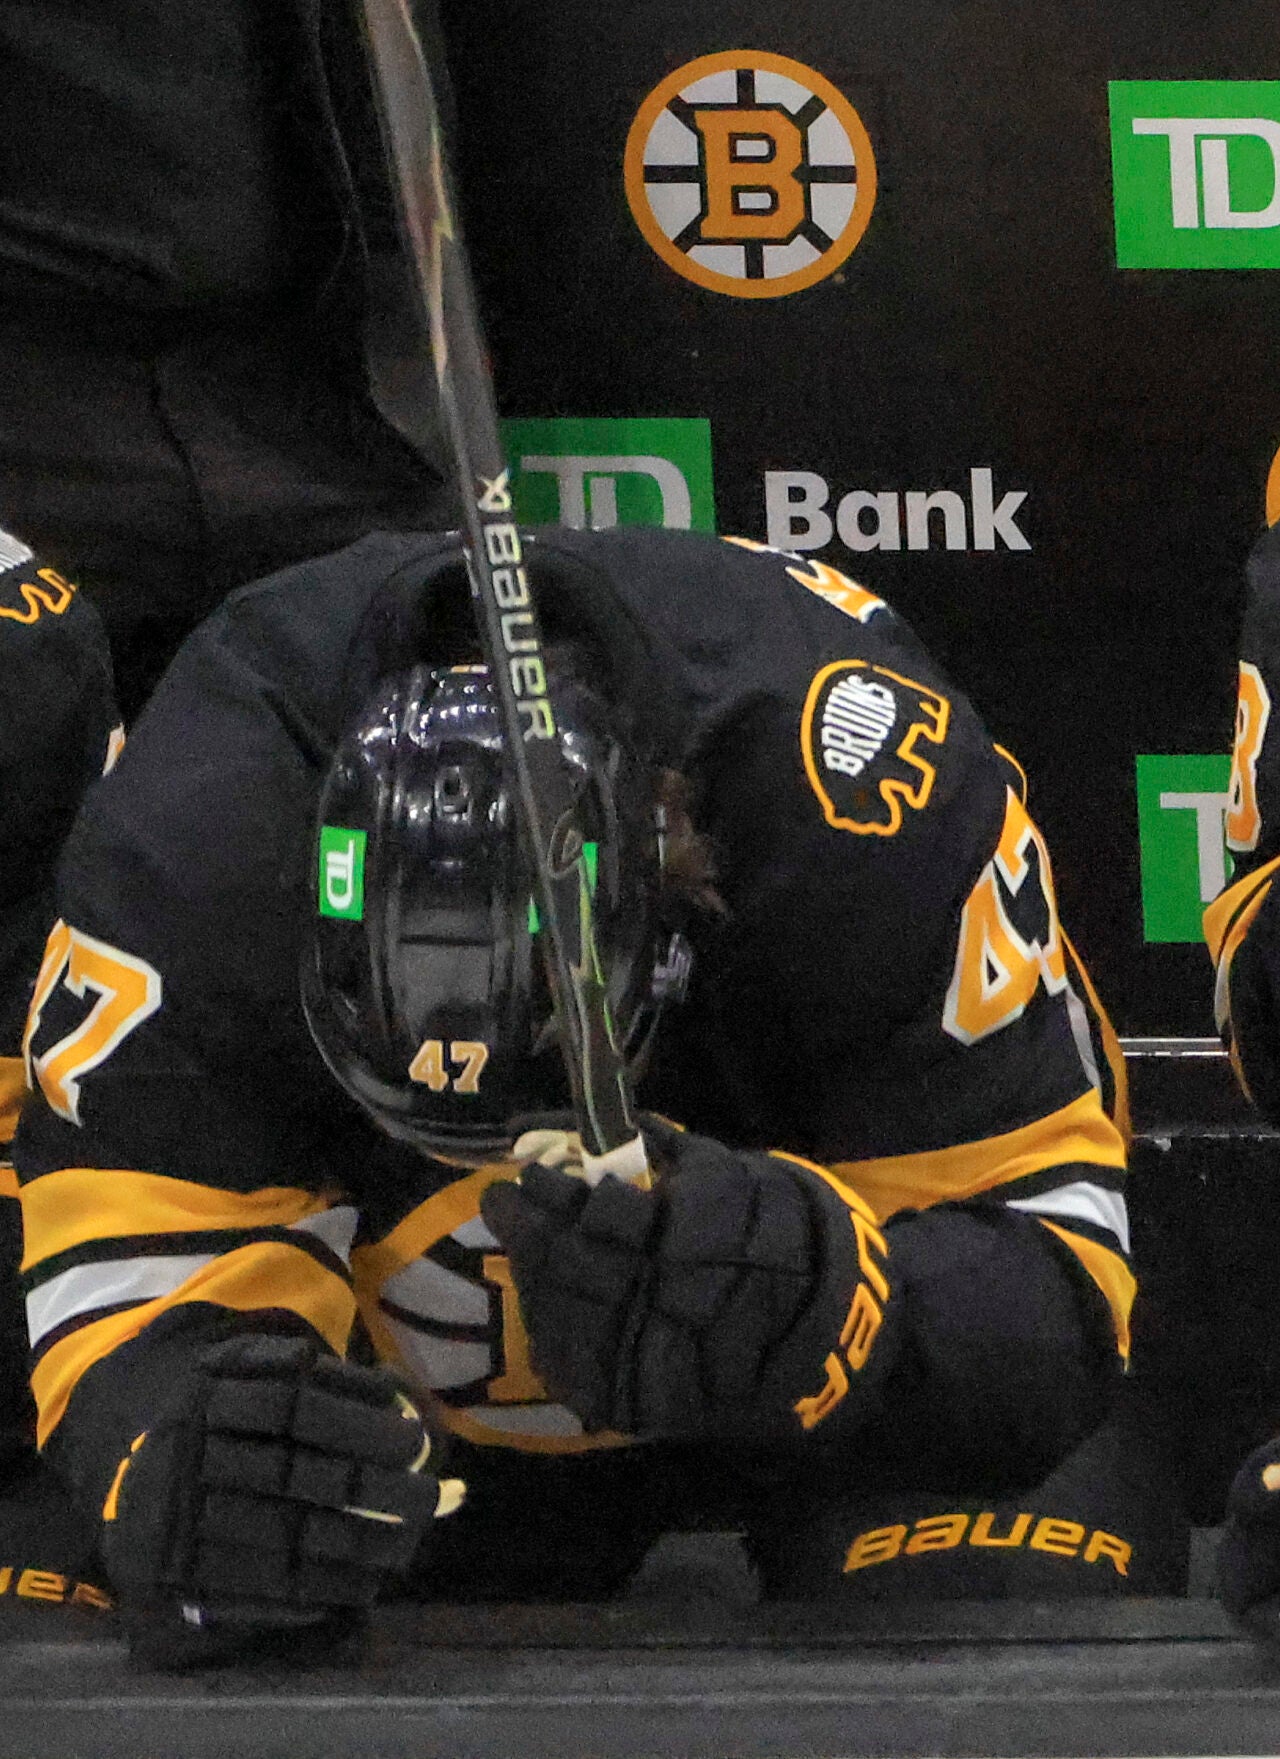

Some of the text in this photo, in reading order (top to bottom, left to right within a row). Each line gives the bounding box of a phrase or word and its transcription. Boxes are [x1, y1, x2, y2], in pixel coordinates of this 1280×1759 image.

[694, 108, 806, 240] B
[765, 468, 1032, 551] Bank
[484, 523, 556, 743] BAUER
[821, 674, 896, 776] BRUINS
[326, 839, 355, 910] TD
[1160, 791, 1235, 902] T
[408, 1039, 489, 1093] 47
[844, 1512, 1132, 1577] BAUER
